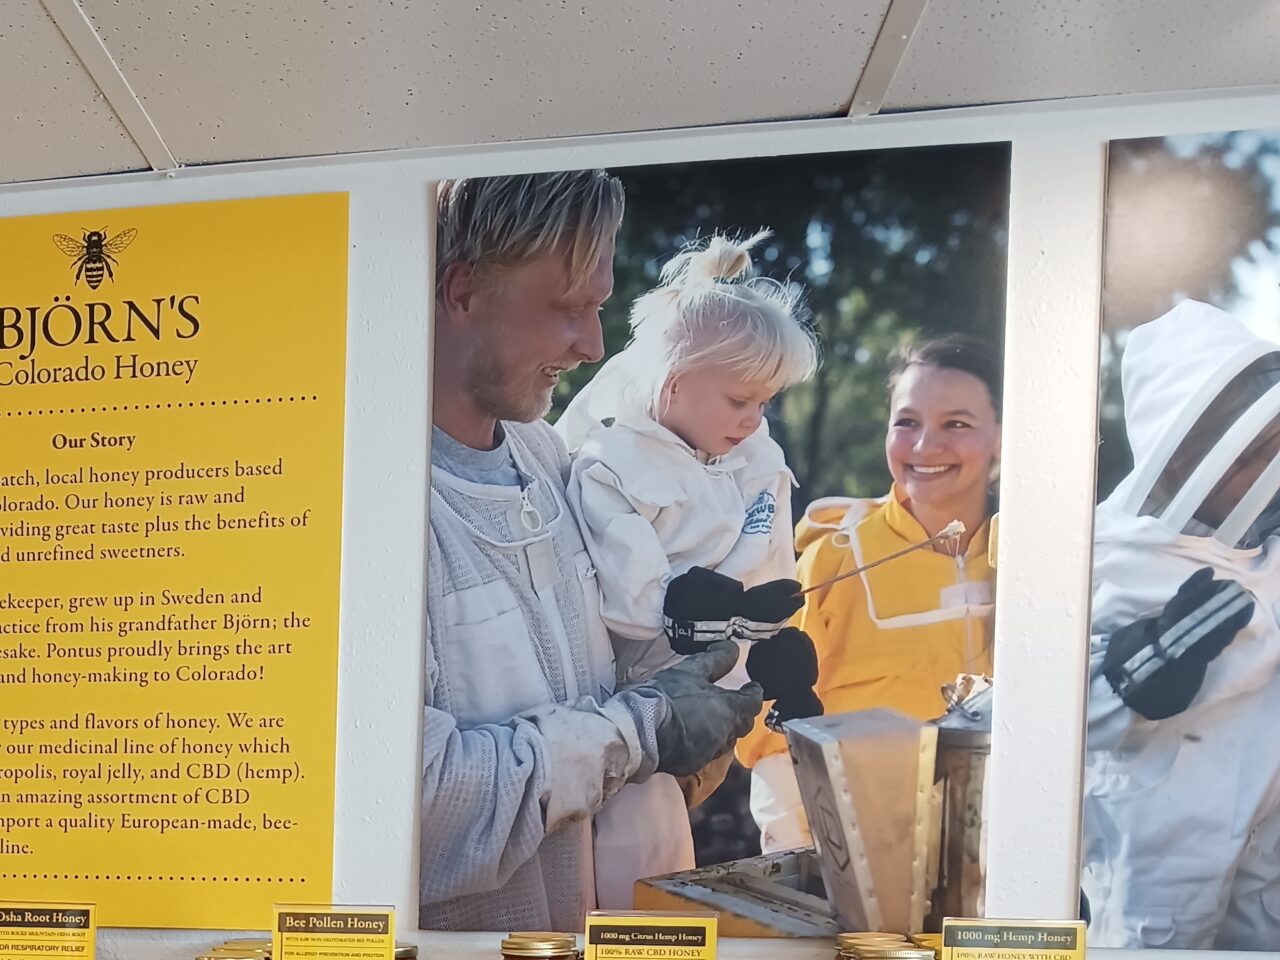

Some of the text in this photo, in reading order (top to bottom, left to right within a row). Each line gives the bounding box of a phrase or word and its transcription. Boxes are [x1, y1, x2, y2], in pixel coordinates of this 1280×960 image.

[113, 355, 199, 385] Honey
[51, 431, 137, 452] Our Story
[45, 466, 83, 485] local
[88, 466, 140, 487] honey
[144, 462, 230, 487] producers
[234, 458, 283, 477] based
[64, 493, 99, 510] Our
[103, 491, 155, 512] honey
[160, 490, 173, 506] is
[178, 493, 208, 506] raw
[213, 485, 245, 504] and
[55, 523, 96, 542] great
[101, 521, 140, 534] taste
[144, 515, 179, 538] plus
[184, 513, 211, 531] the
[216, 510, 285, 530] benefits
[290, 508, 312, 527] of
[16, 543, 94, 562] unrefined
[99, 546, 185, 560] sweetners.
[24, 911, 51, 923] Root
[52, 912, 87, 927] Honey
[285, 916, 385, 933] Bee Pollen Honey
[618, 934, 631, 942] mg
[630, 932, 654, 940] Citrus
[654, 932, 678, 943] Hemp
[678, 933, 703, 943] Honey
[957, 930, 1073, 945] 1000 mg Hemp Honey
[10, 944, 60, 952] RESPIRATORY
[60, 945, 86, 953] RELIEF
[600, 948, 703, 957] 100% RAW CBD HONEY
